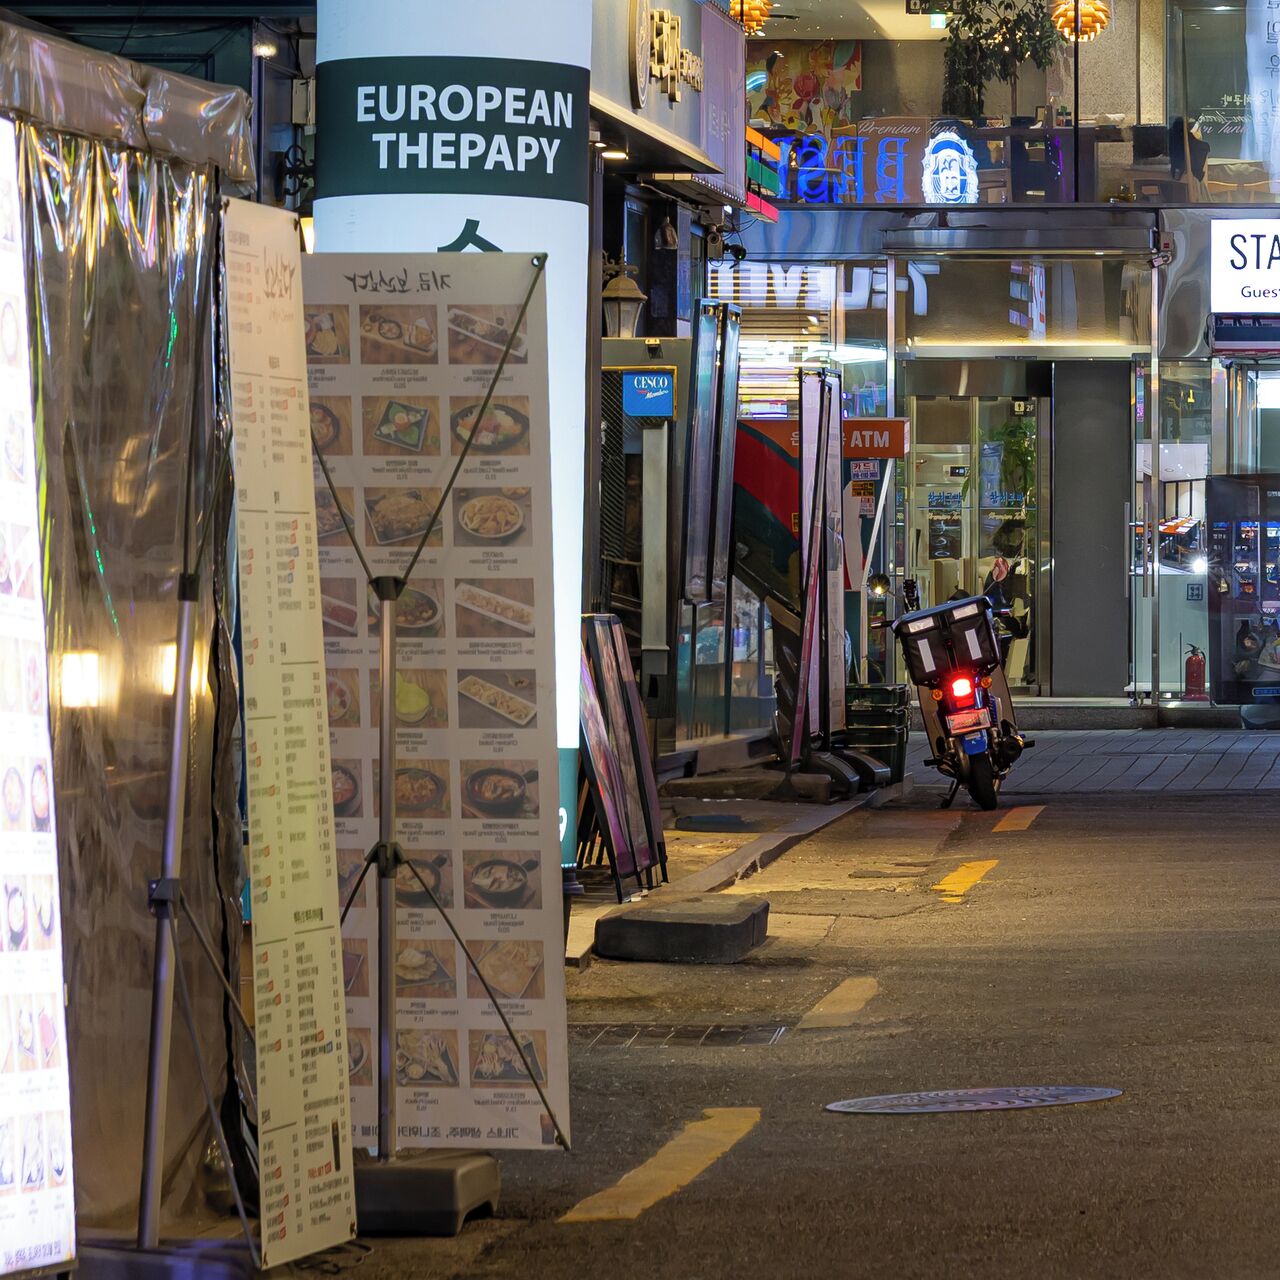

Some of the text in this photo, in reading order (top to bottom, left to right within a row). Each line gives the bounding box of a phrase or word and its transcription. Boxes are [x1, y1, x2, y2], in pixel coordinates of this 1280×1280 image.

[356, 84, 573, 129] EUROPEAN
[371, 132, 561, 175] THEPAPY
[633, 375, 669, 390] CESCO
[850, 430, 890, 448] ATM
